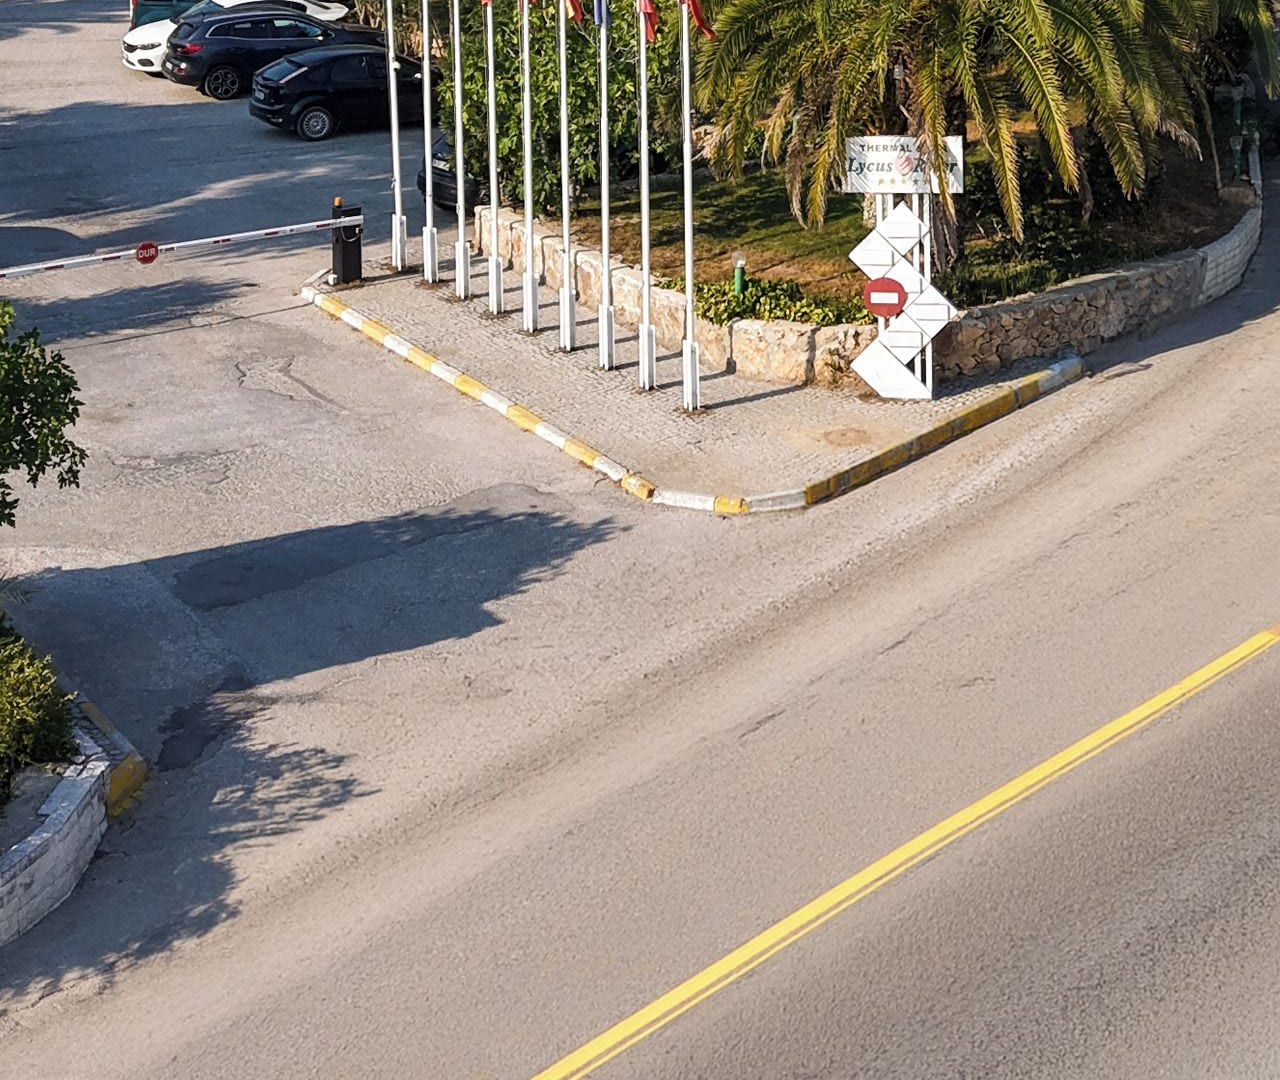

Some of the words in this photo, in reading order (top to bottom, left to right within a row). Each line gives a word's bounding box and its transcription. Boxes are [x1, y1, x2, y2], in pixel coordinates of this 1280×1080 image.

[860, 143, 912, 153] THERMAL
[848, 156, 894, 176] Lycus
[138, 247, 156, 259] DUR
